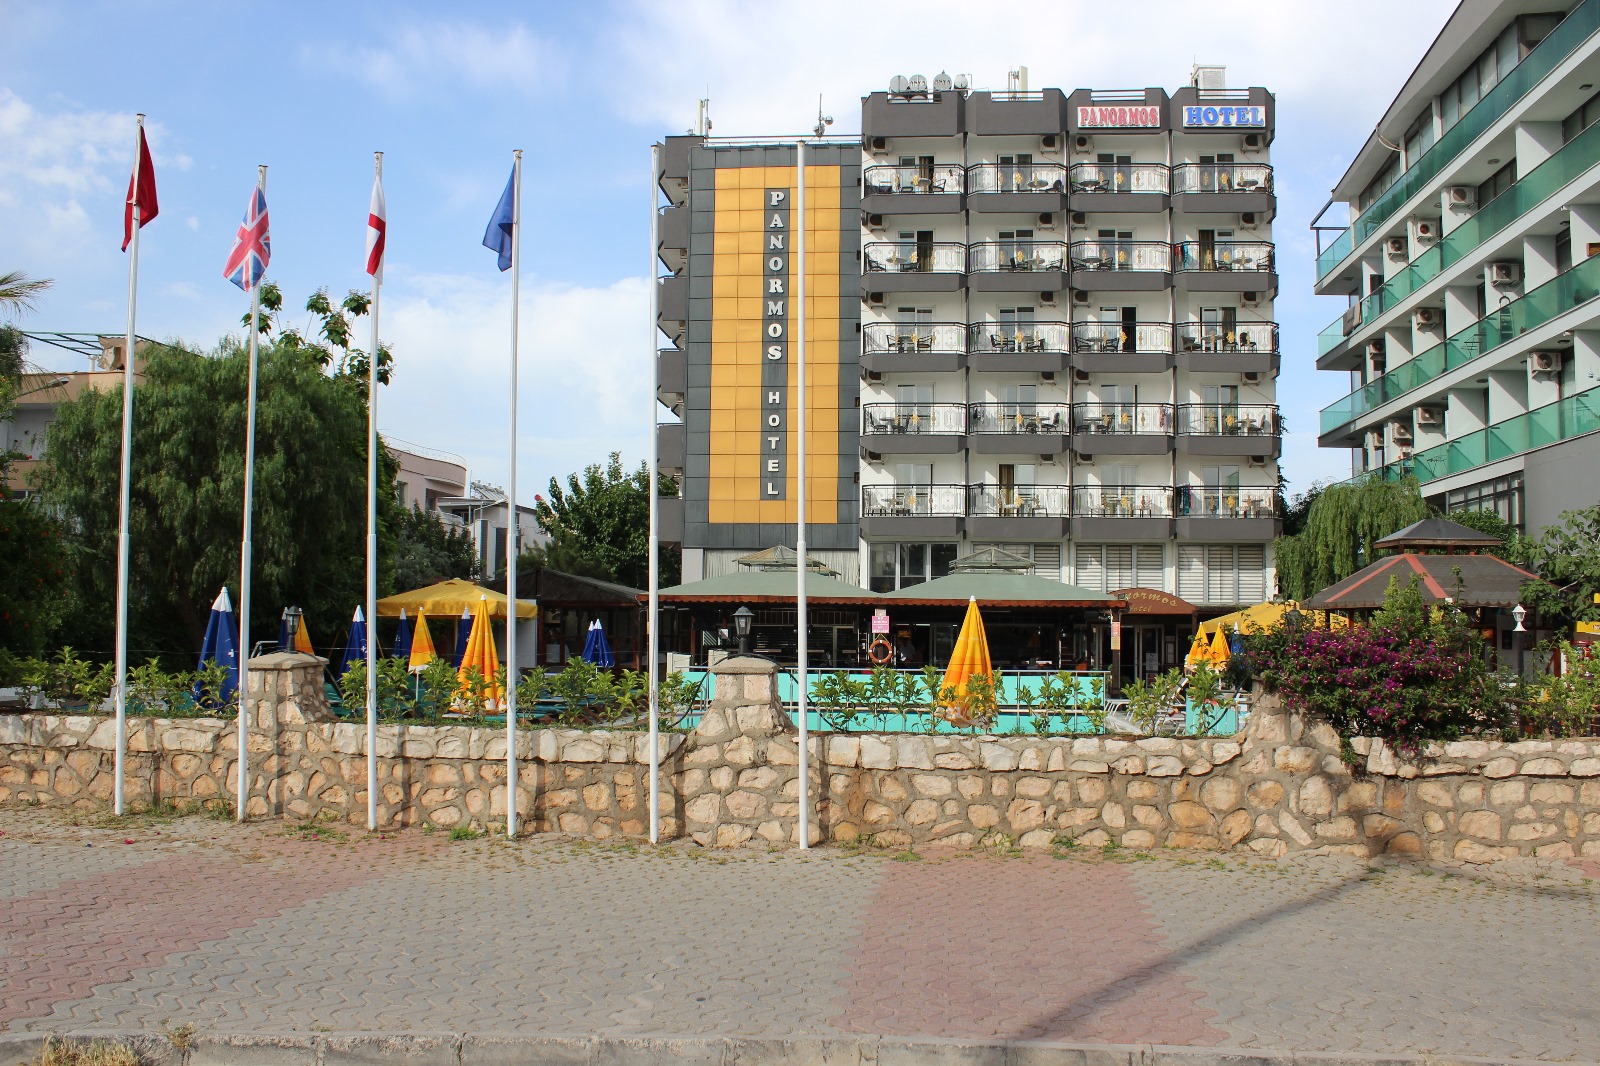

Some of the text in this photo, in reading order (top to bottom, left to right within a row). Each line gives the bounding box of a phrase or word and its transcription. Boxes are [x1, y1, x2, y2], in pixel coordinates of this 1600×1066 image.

[1080, 107, 1264, 126] PANORMOS HOTEL
[767, 191, 785, 495] PANORMOS HOTEL
